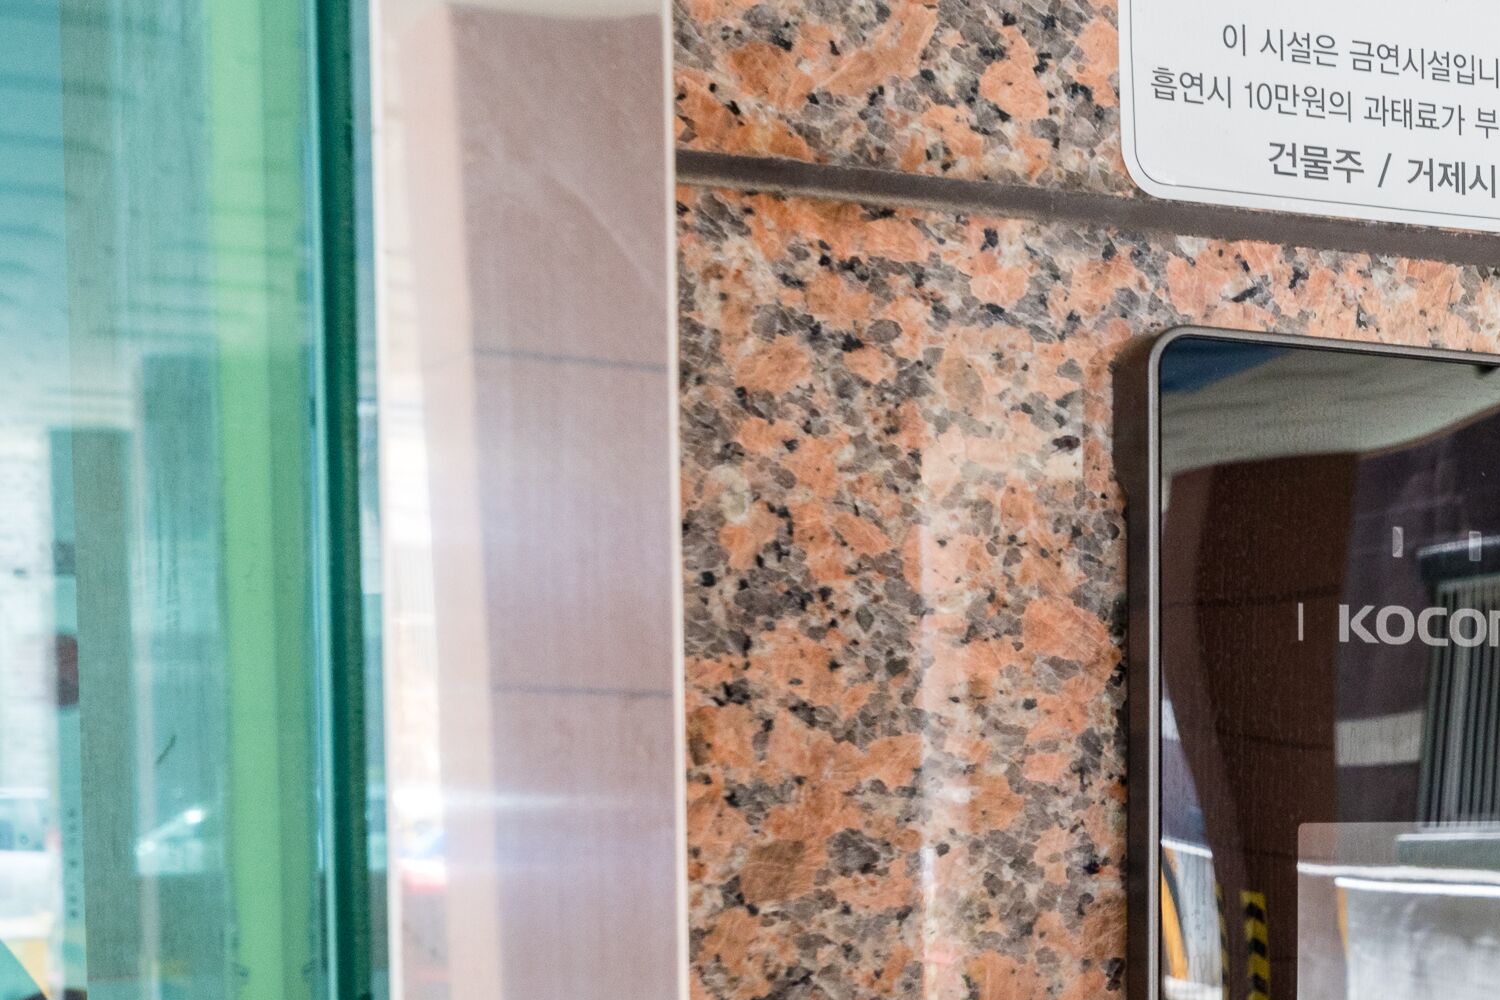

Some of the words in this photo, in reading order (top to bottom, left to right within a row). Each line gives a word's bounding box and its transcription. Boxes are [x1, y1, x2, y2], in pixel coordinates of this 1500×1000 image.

[1222, 24, 1247, 56] 이
[1260, 29, 1339, 68] 시설은
[1150, 66, 1232, 109] 흡연시
[1244, 82, 1352, 122] 10만원의
[1363, 94, 1465, 136] 과태료가
[1268, 143, 1364, 184] 건물주
[1378, 153, 1393, 187] /
[1407, 158, 1497, 198] 거제시
